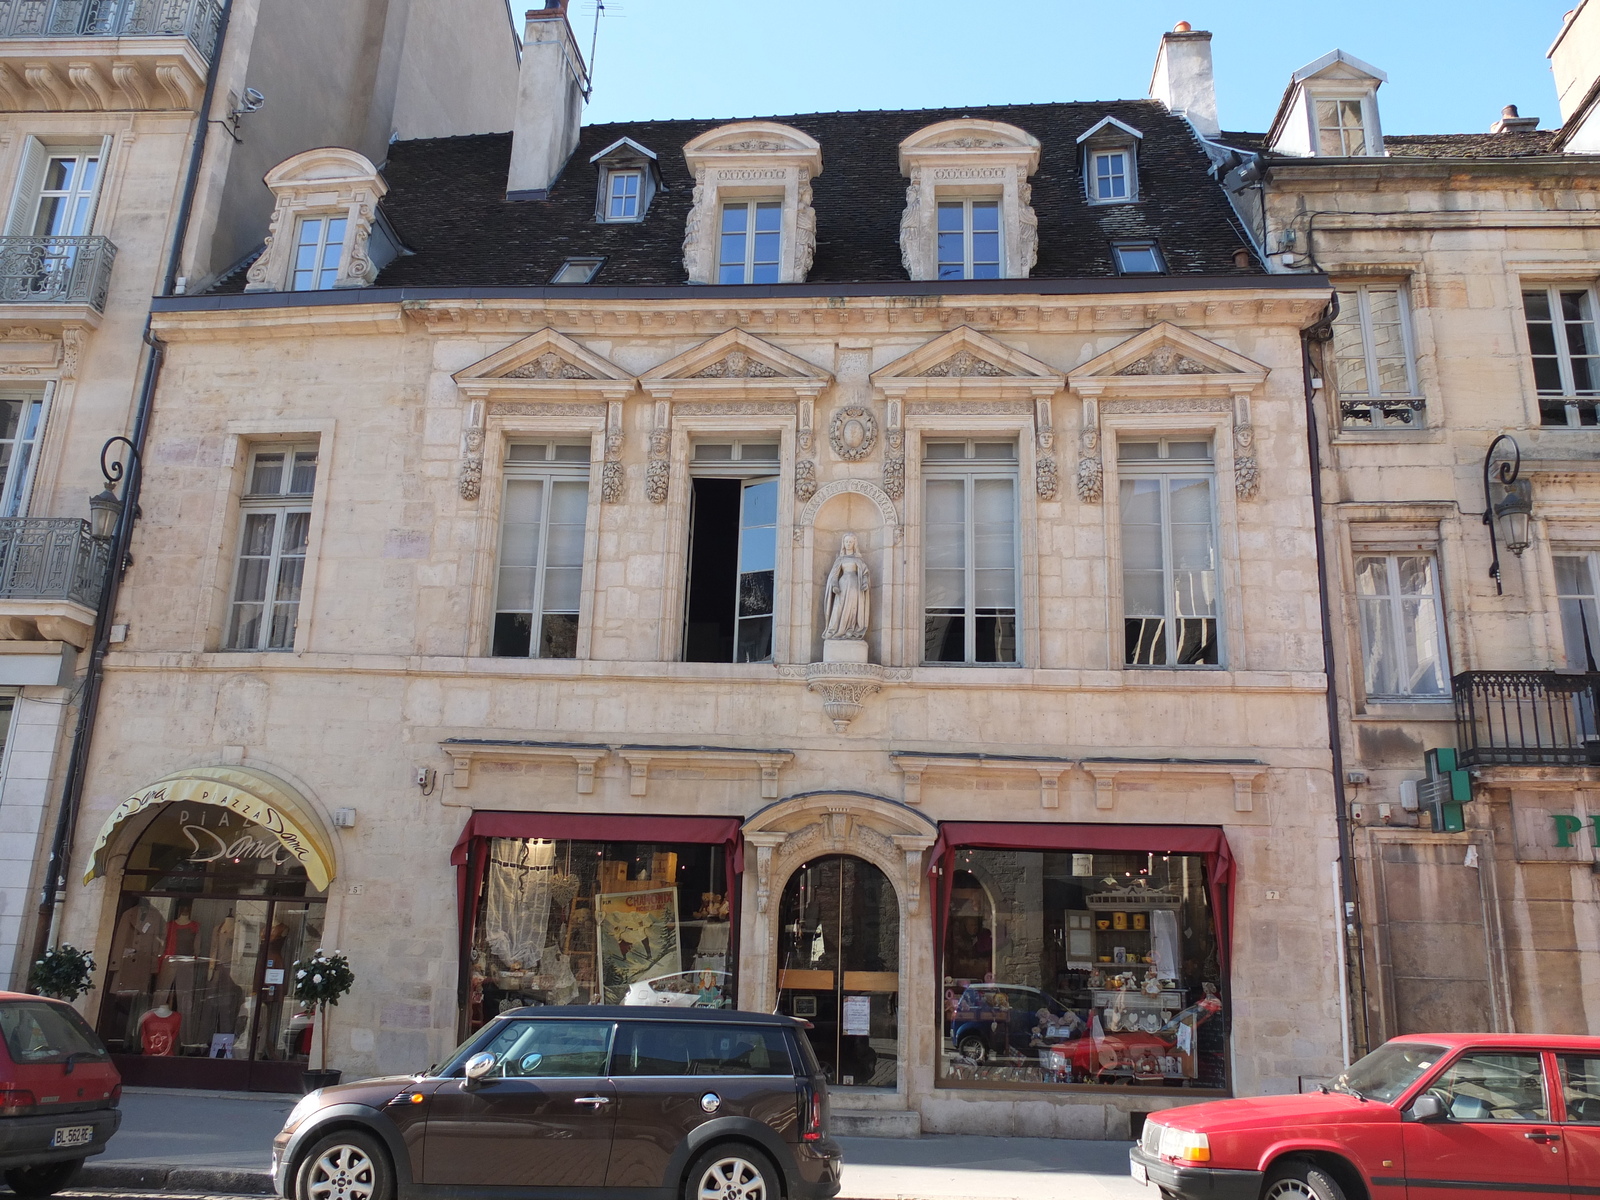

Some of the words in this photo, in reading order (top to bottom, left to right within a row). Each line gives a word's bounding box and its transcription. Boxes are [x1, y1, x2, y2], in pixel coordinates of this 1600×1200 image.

[122, 787, 167, 815] Doa
[179, 810, 252, 827] PiAZ
[182, 824, 292, 864] Donna
[262, 807, 309, 861] Donna
[353, 886, 358, 894] 5
[1270, 891, 1275, 899] 7
